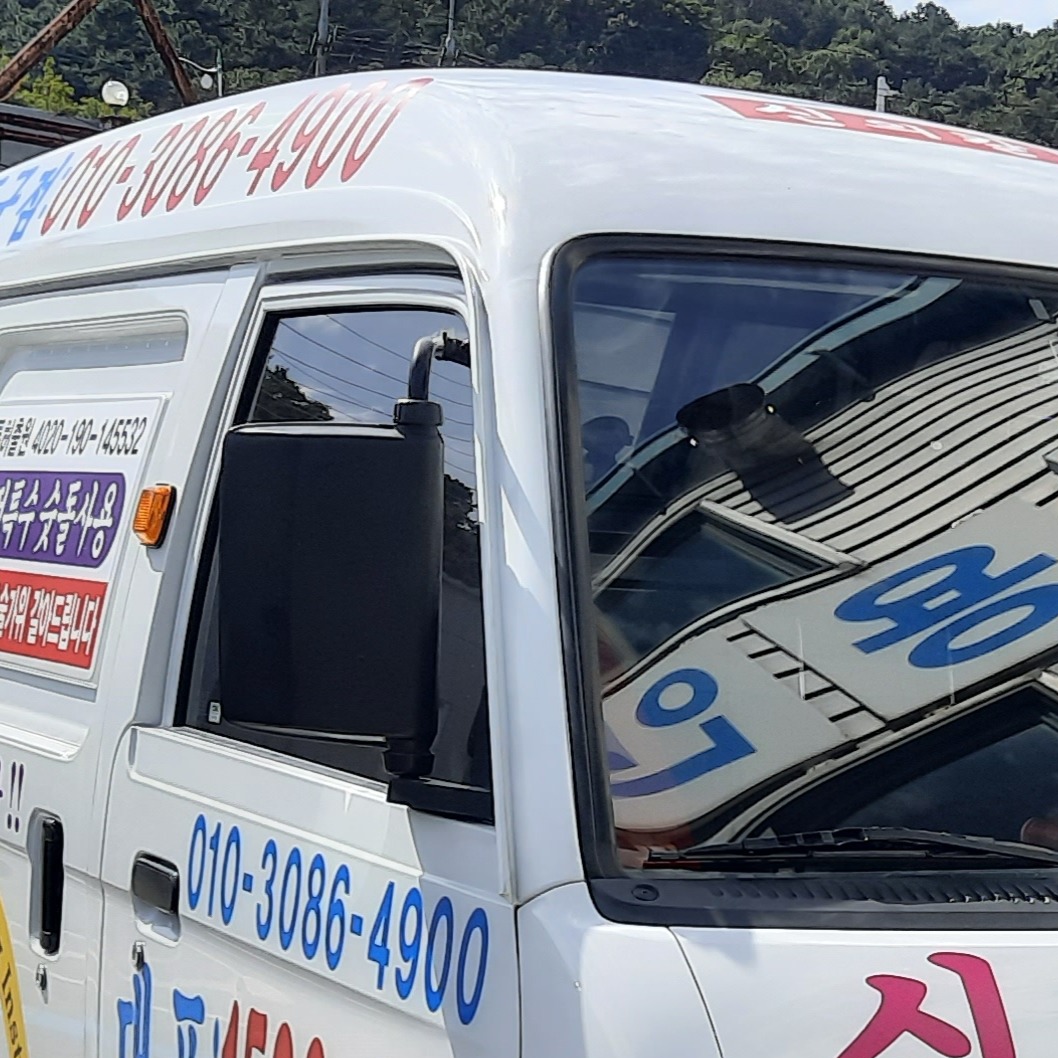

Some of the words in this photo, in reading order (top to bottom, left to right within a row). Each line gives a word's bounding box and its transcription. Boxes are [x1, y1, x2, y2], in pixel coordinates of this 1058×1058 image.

[40, 77, 434, 236] 010-3086-4900
[27, 586, 101, 656] 갈아드립니다
[187, 813, 490, 1025] 010-3086-4900
